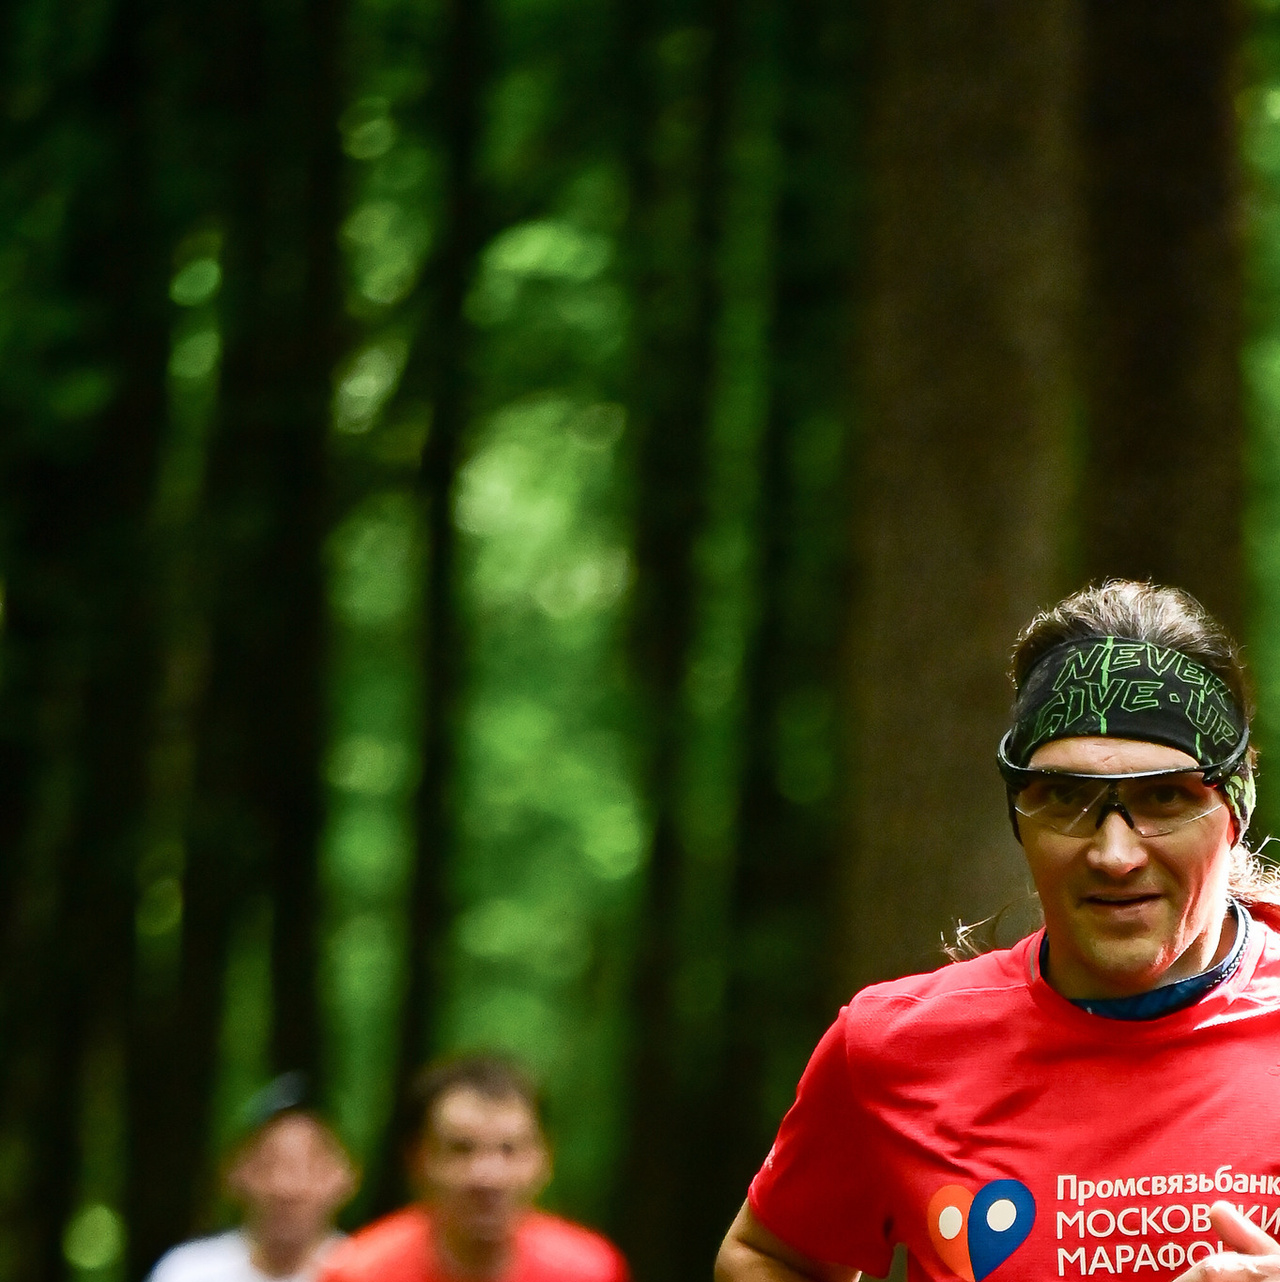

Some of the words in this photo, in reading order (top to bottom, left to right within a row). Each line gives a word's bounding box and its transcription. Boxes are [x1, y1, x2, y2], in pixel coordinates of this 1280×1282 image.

[1052, 642, 1230, 712] NEVER
[1031, 678, 1164, 743] GIVE
[1186, 689, 1240, 746] UP
[1057, 1240, 1224, 1277] МАРАФО
